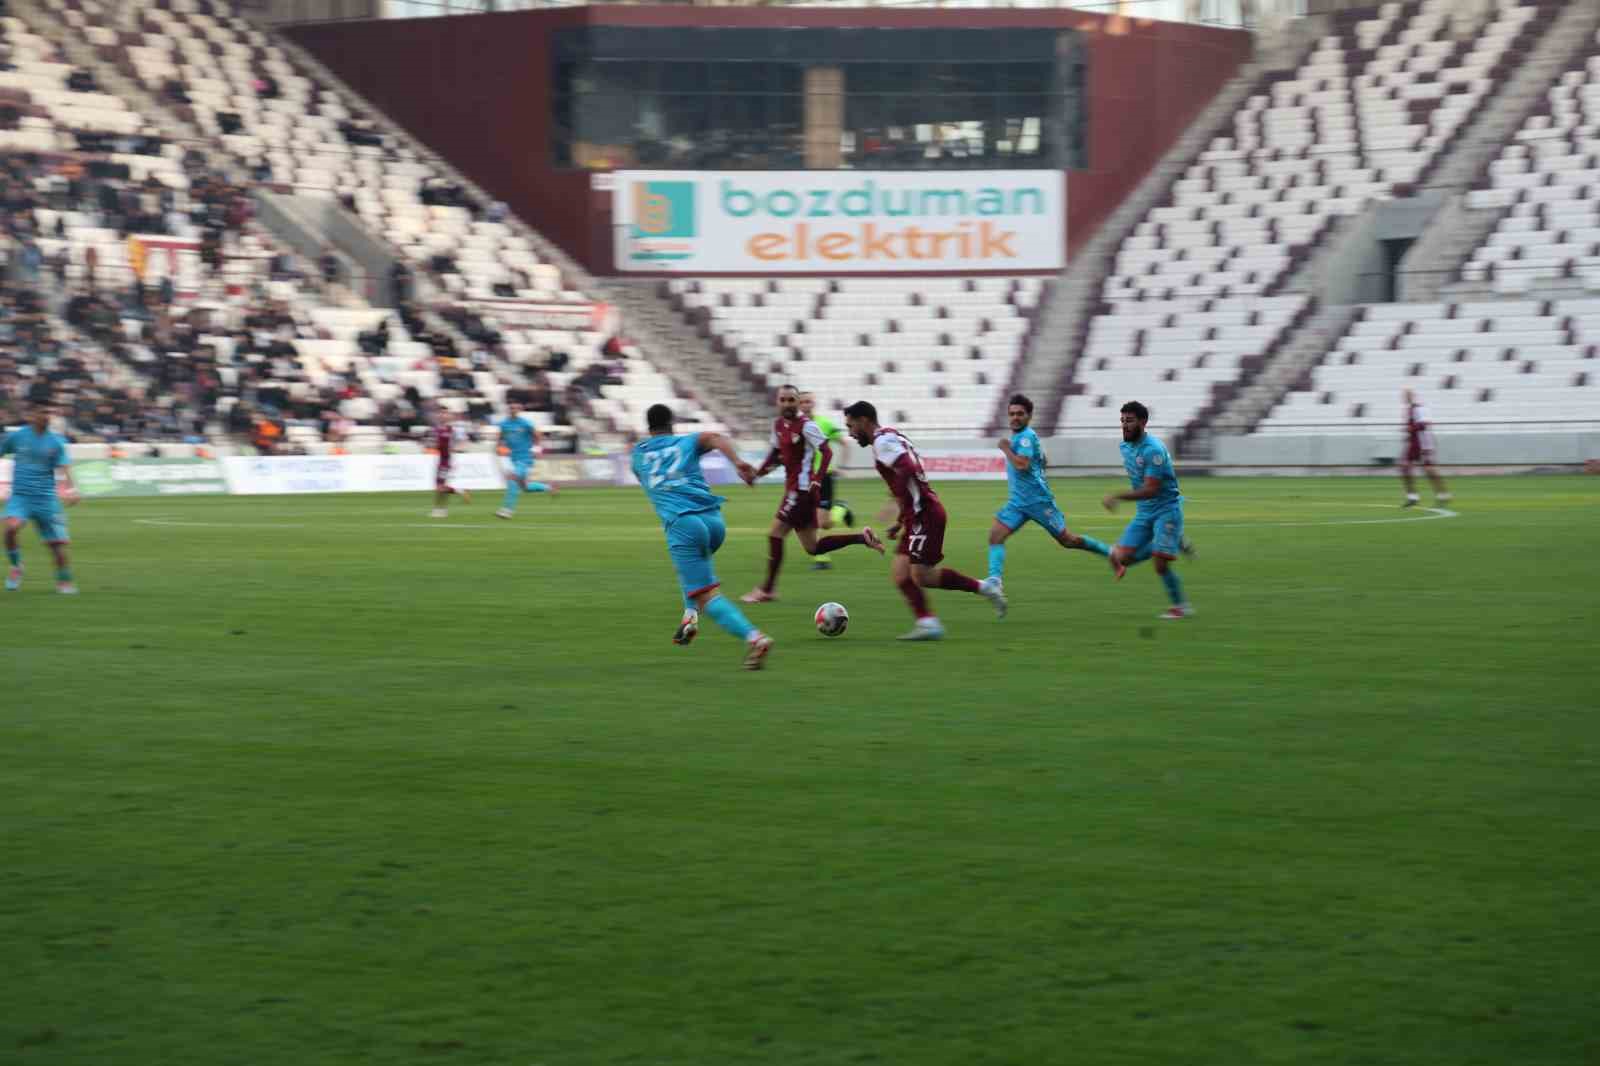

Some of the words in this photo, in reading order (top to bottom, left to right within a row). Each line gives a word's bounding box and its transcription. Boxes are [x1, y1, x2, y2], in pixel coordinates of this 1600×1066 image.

[721, 181, 1044, 217] bozduman
[745, 222, 1017, 260] elektrik
[909, 535, 927, 551] 77
